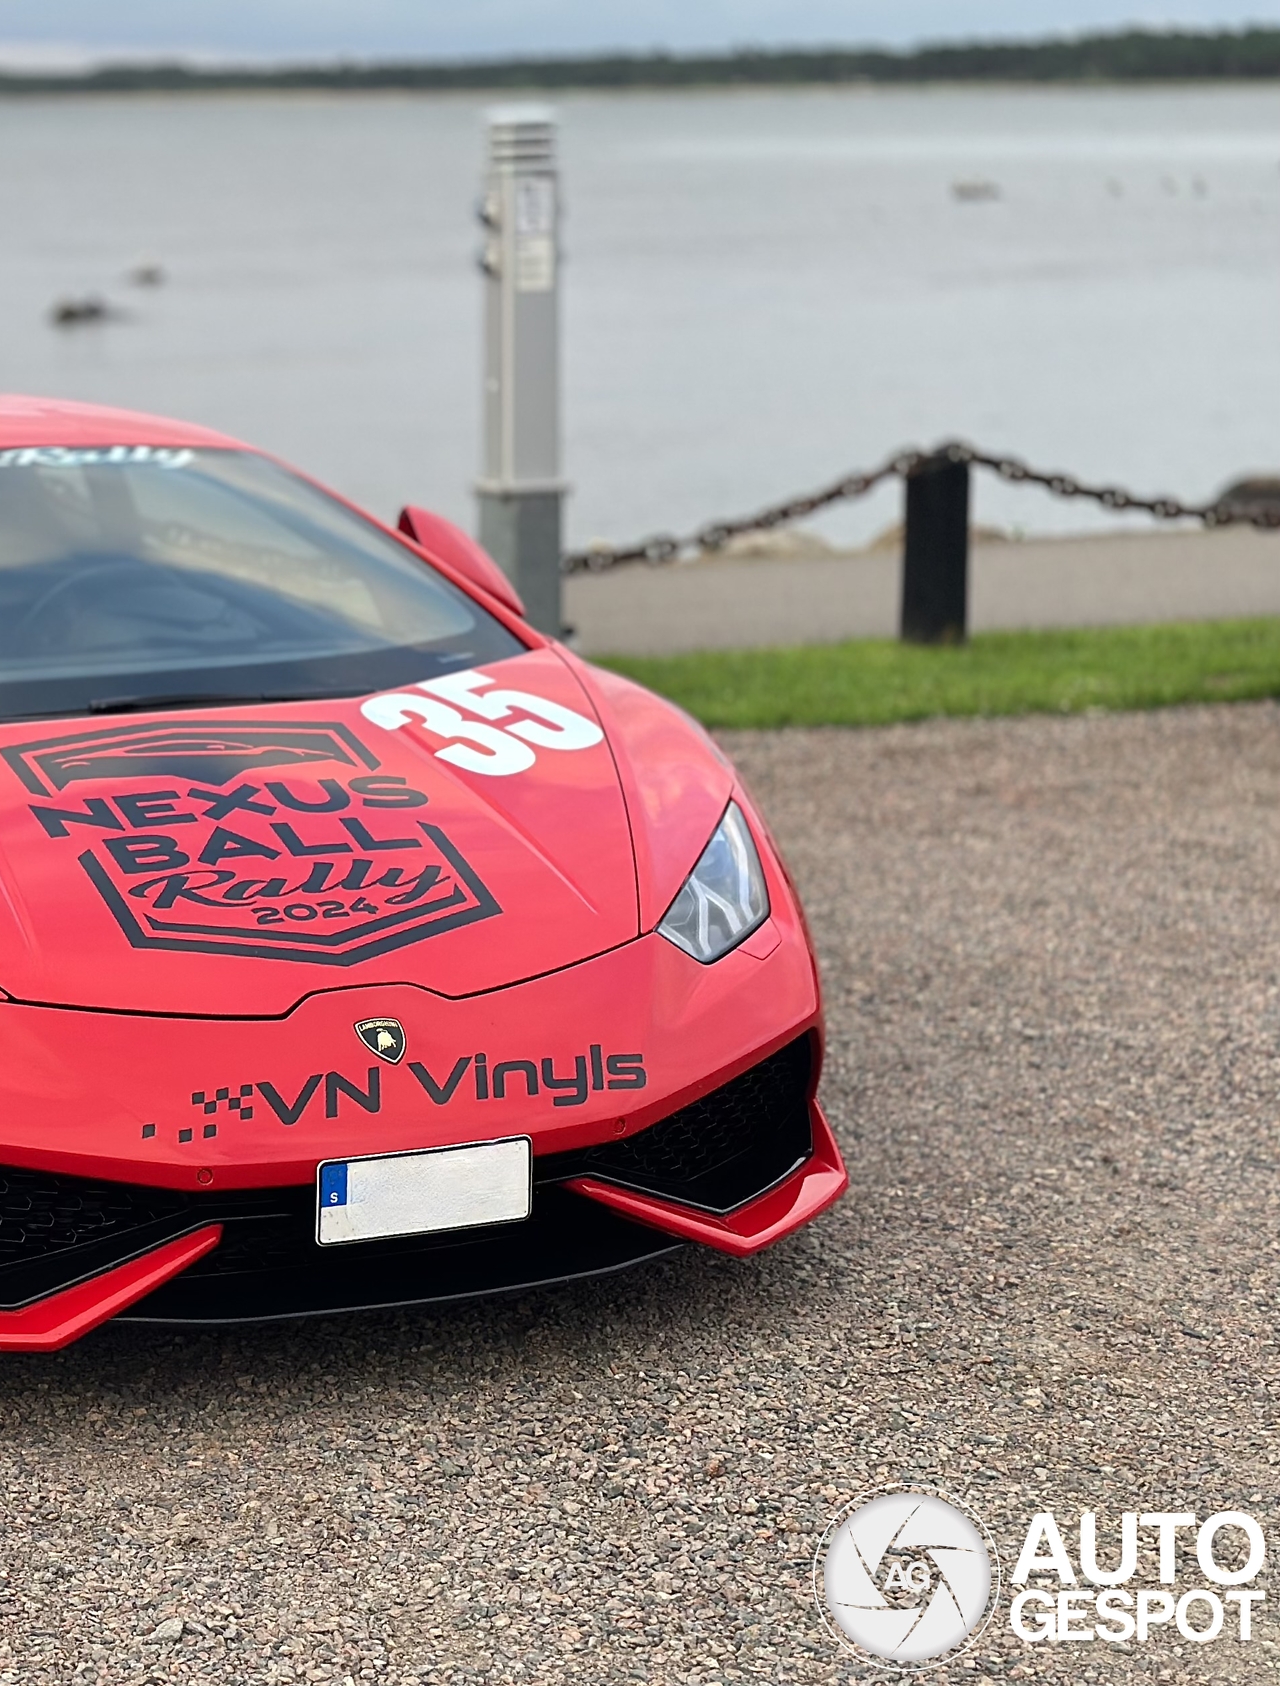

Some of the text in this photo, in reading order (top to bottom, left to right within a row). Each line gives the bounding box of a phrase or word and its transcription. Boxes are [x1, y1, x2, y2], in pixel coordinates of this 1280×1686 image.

[360, 670, 604, 776] 35
[27, 775, 429, 838] NEXUS
[102, 817, 424, 875] BALL
[128, 859, 452, 908] Rally
[251, 896, 380, 926] 2024
[258, 1044, 647, 1126] VN Vinyls
[330, 1192, 339, 1203] S
